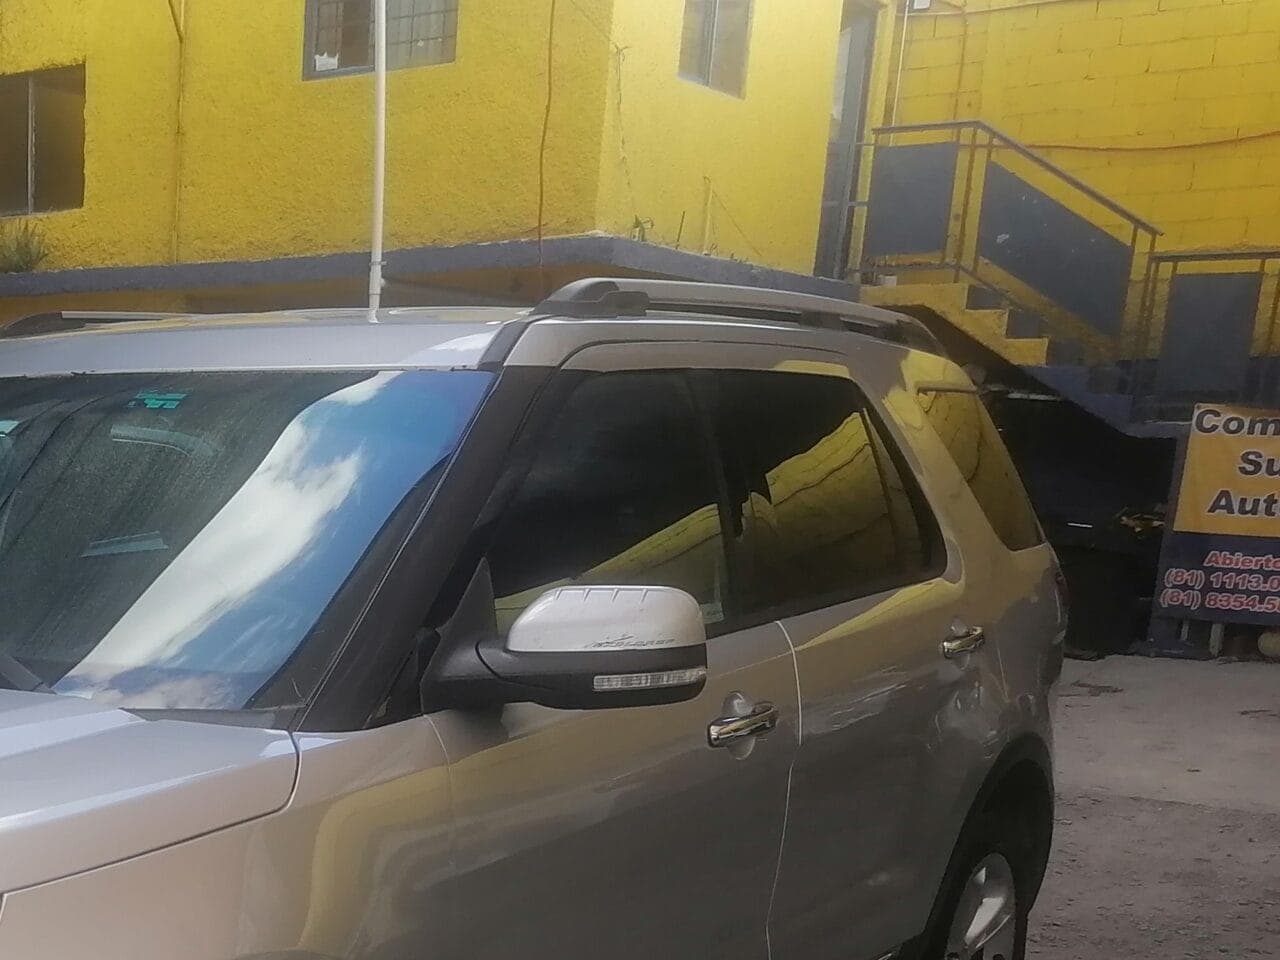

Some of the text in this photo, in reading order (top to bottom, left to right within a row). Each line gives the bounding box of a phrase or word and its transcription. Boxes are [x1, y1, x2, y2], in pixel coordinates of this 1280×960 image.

[1194, 408, 1280, 436] Com
[1164, 568, 1205, 589] (81)
[1160, 588, 1280, 614] (81) 8354.5
